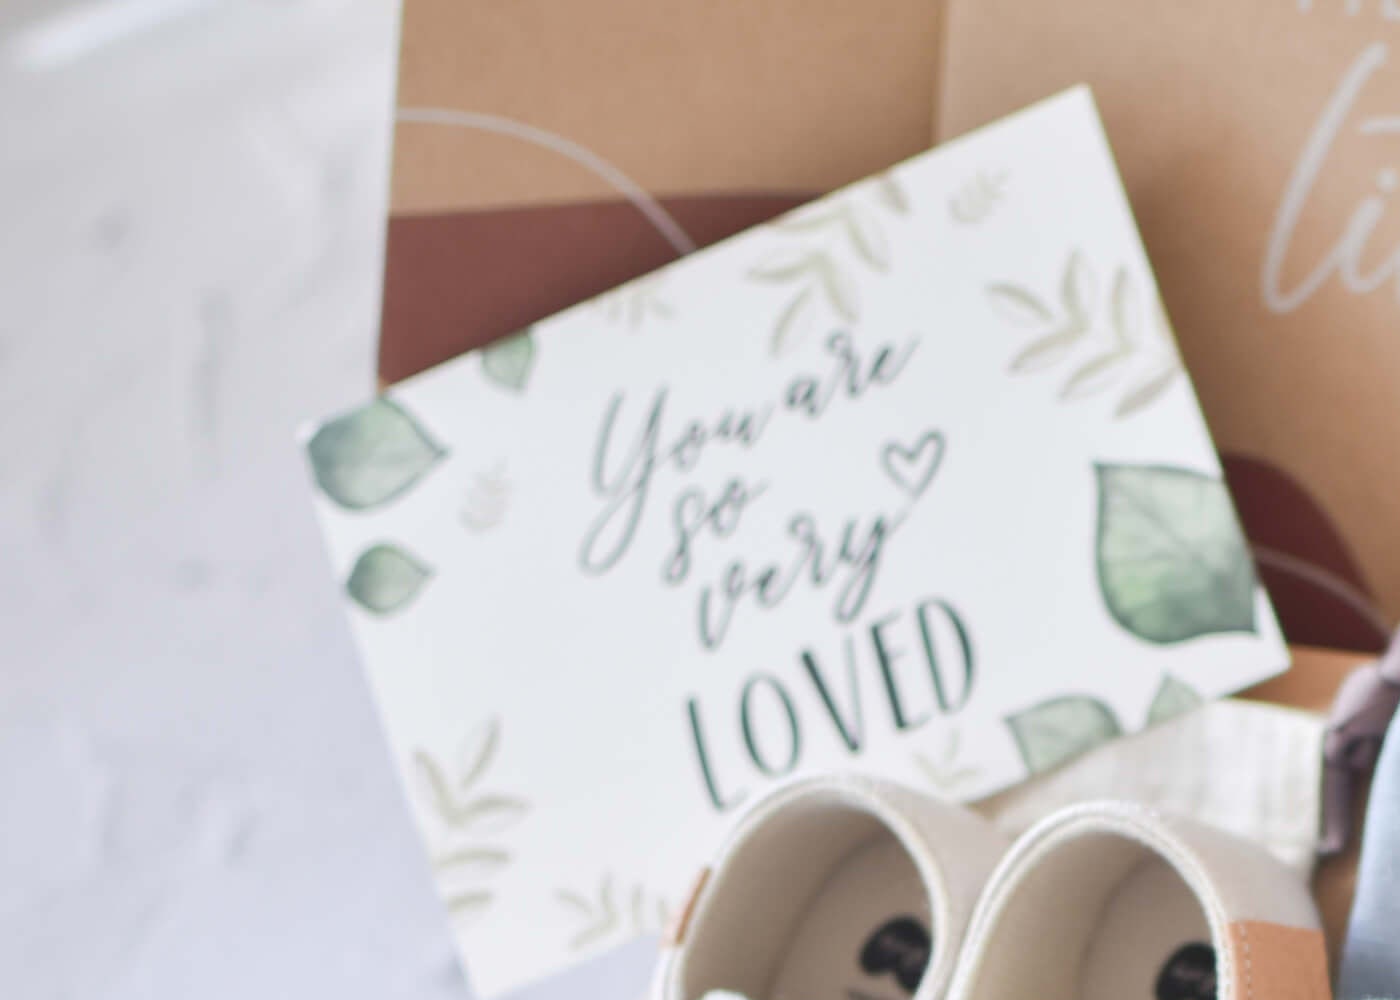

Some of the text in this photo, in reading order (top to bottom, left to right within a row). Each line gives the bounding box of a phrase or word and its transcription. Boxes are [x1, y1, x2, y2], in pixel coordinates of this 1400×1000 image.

[576, 331, 920, 575] You are
[661, 476, 768, 585] so
[697, 511, 892, 651] very
[686, 596, 976, 812] LOVED
